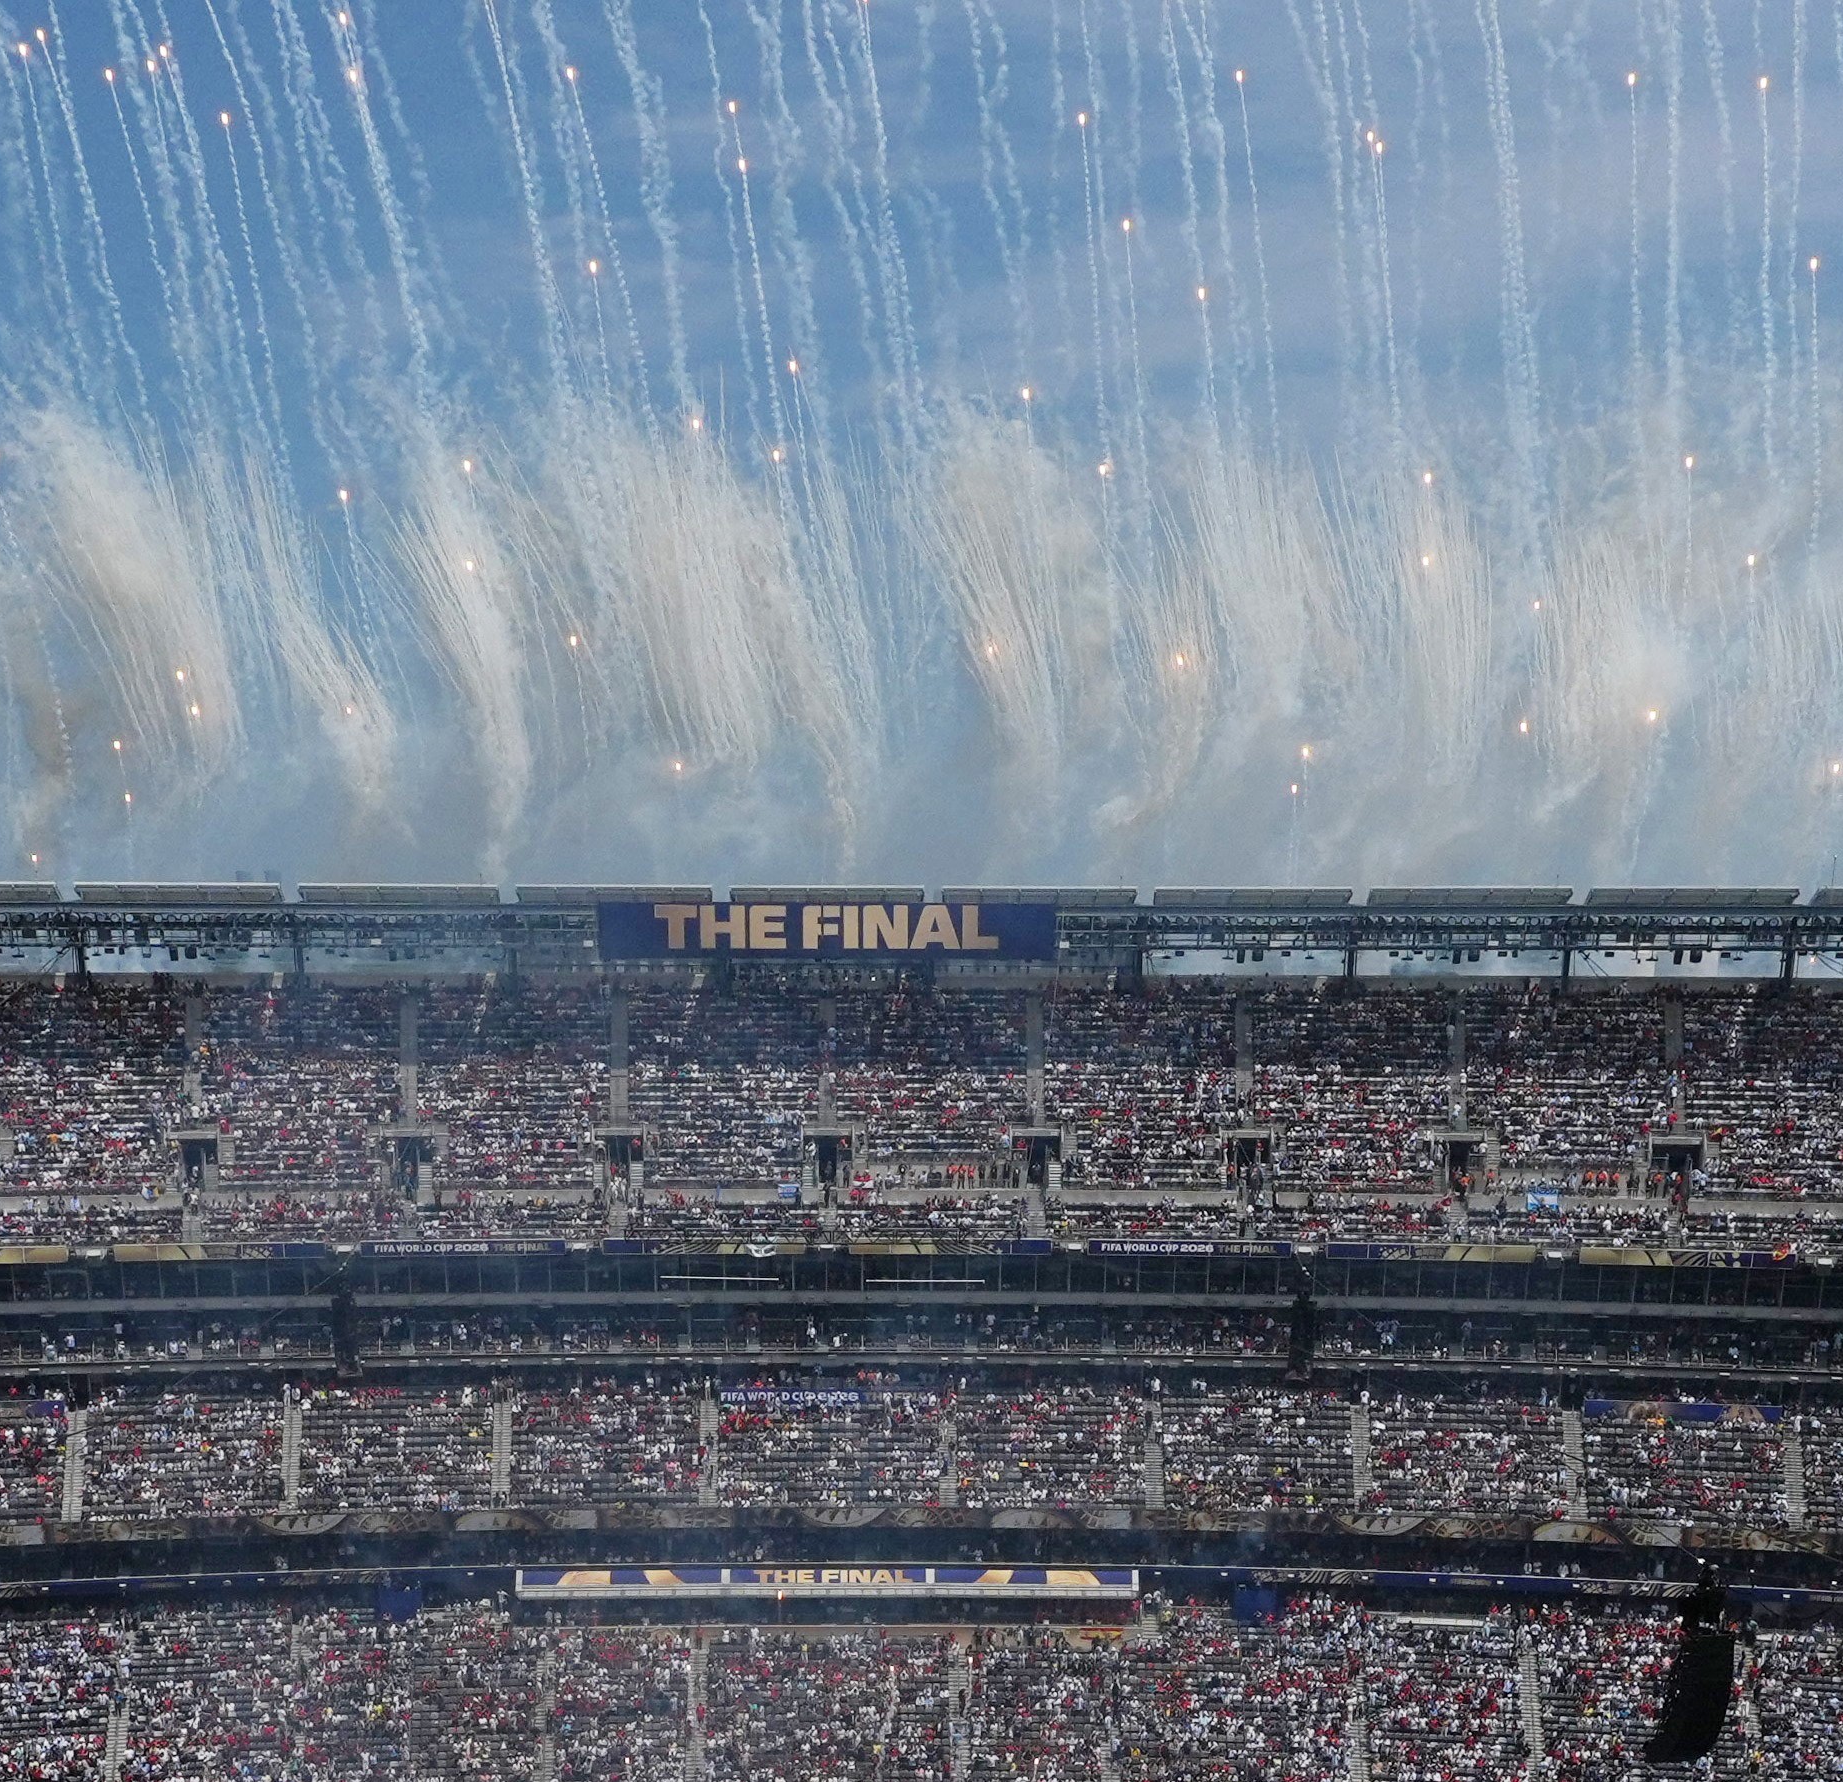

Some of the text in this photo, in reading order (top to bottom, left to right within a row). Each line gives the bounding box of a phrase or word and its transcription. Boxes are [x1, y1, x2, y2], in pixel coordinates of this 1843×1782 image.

[654, 904, 1000, 949] THE FINAL
[374, 1244, 395, 1253] FIFA
[396, 1244, 432, 1253] WORLD
[433, 1243, 453, 1252] CUP
[454, 1243, 489, 1252] 2026
[1101, 1243, 1278, 1254] FIFA WORLD CUP 2026 THE FINAL
[720, 1391, 746, 1402] FIFA
[746, 1391, 790, 1402] WORD
[753, 1569, 913, 1584] THE FINAL
